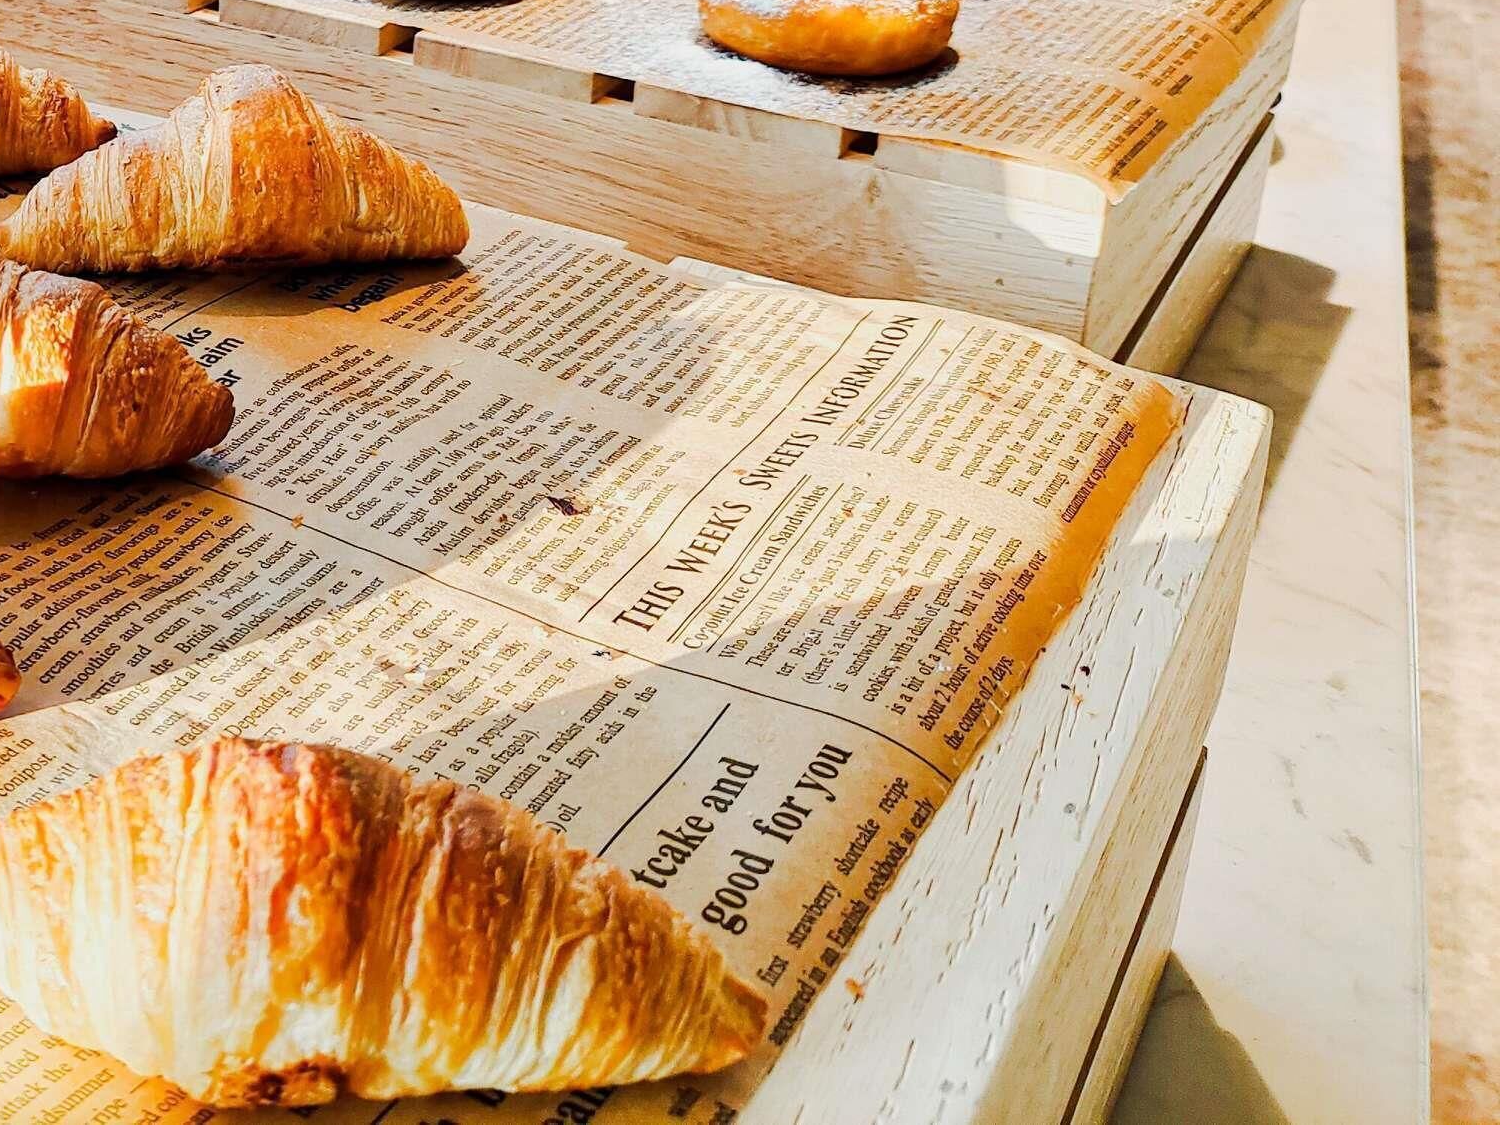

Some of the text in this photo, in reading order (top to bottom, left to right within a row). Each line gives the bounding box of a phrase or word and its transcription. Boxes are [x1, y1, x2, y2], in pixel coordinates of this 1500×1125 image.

[611, 314, 921, 633] THIS WEEK'S SWEETS INFORMATION
[721, 586, 750, 605] Ice
[739, 545, 782, 585] Cream
[768, 484, 829, 546] Sandwiches
[833, 516, 971, 694] is sandwiched between lemony butter
[862, 525, 997, 703] cookies, with a dash of grated coconut. This
[890, 536, 1023, 716] is a bit of a project, but it only requires
[11, 738, 36, 751] in
[701, 756, 760, 814] and
[700, 743, 854, 936] good for you
